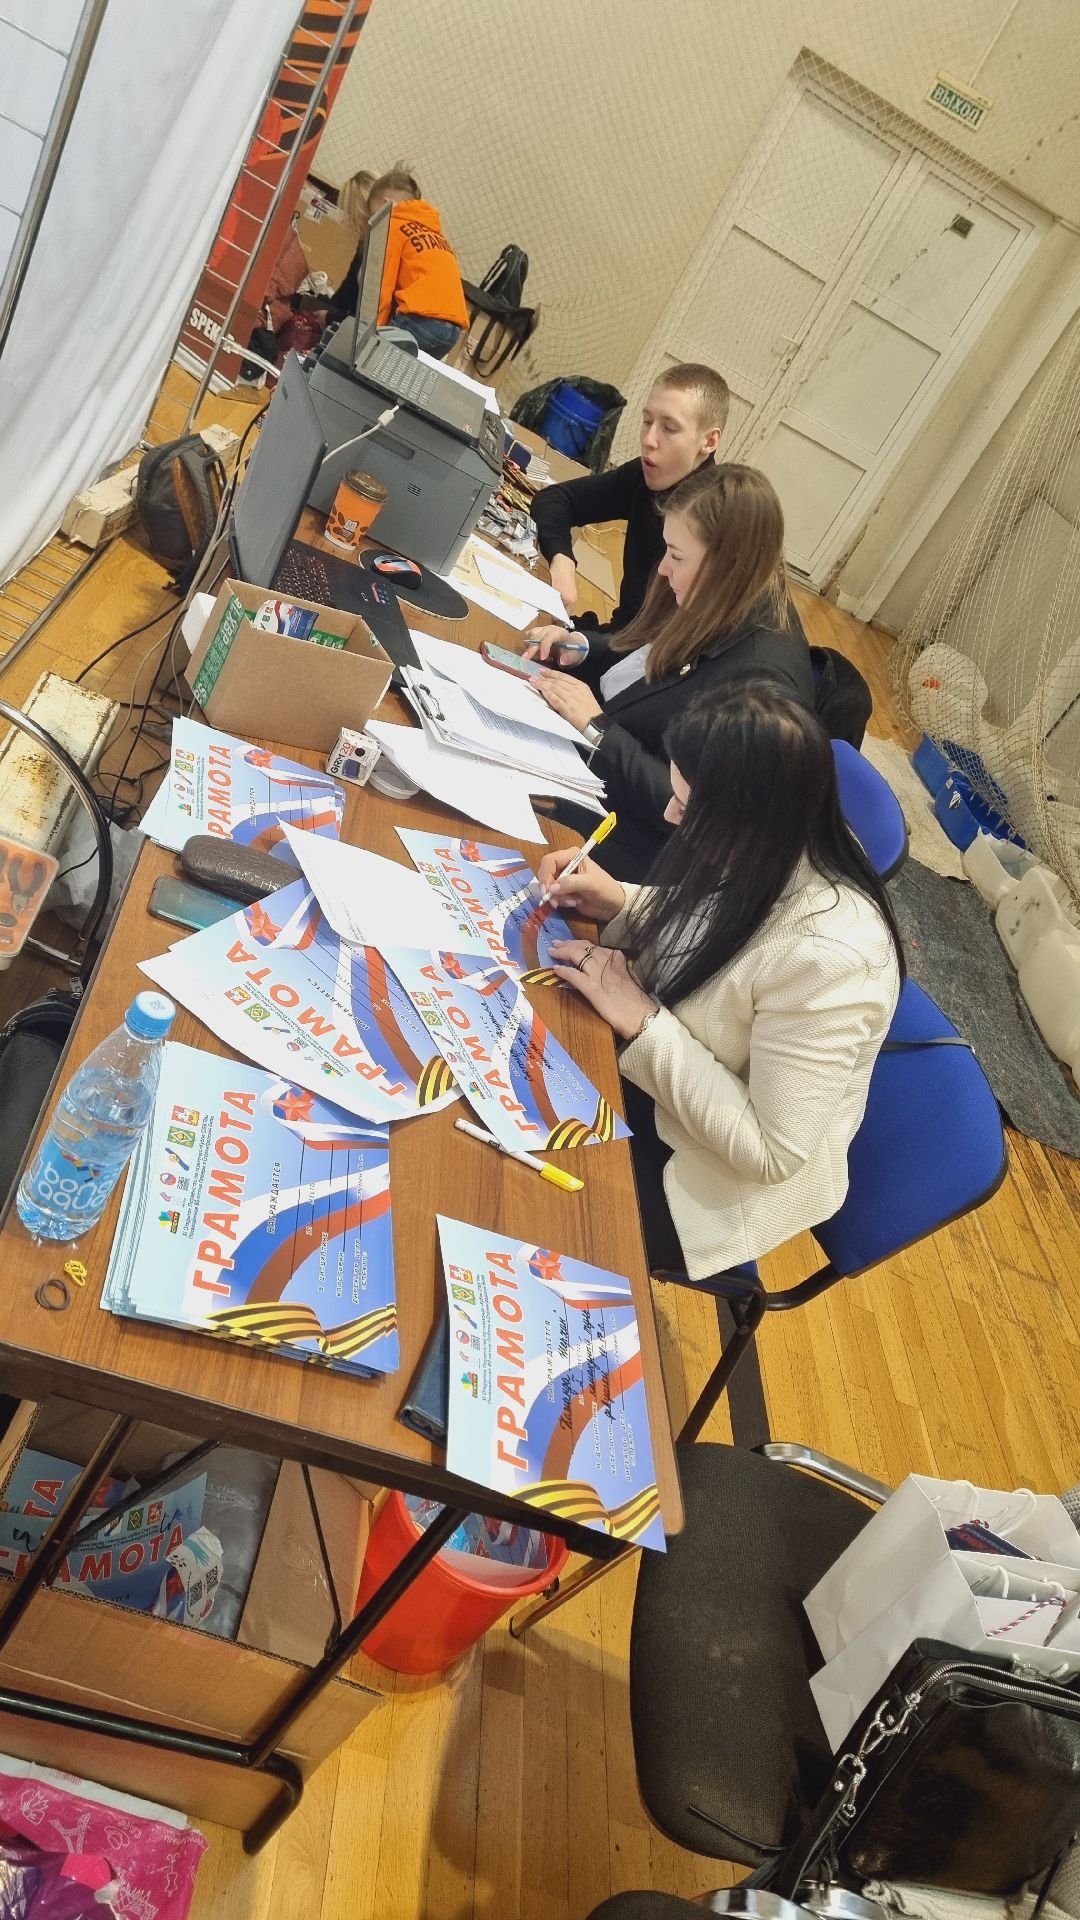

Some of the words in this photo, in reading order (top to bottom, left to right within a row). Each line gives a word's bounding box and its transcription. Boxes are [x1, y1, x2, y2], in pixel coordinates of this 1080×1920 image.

[933, 87, 980, 123] ВЫХОД
[208, 745, 232, 836] РАМОТА
[331, 754, 346, 773] GRM
[340, 742, 351, 754] 20
[432, 846, 518, 968] ГРАМОТА
[227, 942, 405, 1097] ГРАМОТА
[418, 965, 540, 1132] ГРАМОТА
[192, 1092, 256, 1296] ГРАМОТА
[267, 1161, 281, 1233] НАГРАЖДАЕТСЯ
[486, 1252, 527, 1468] ГРАМОТА
